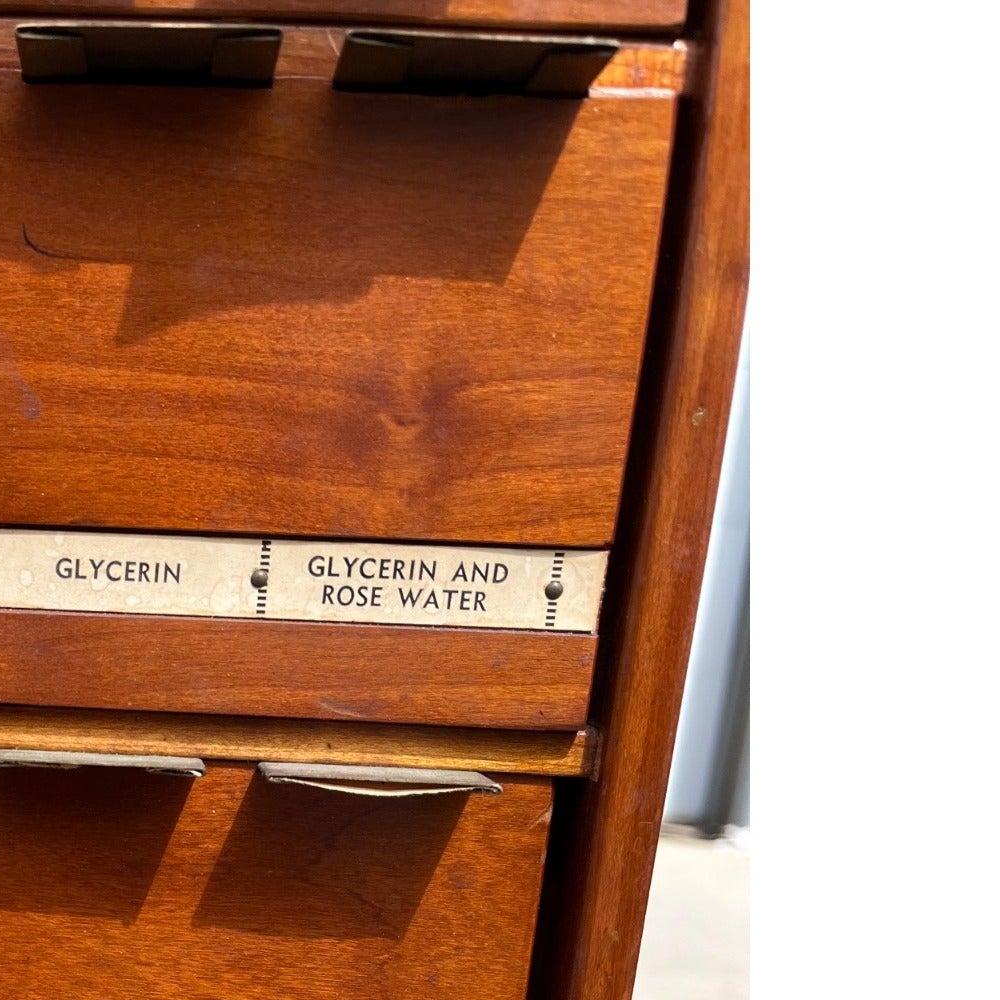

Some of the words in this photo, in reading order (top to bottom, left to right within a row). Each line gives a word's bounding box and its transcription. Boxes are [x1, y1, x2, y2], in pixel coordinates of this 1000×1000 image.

[54, 556, 183, 586] GLYCERIN
[307, 554, 438, 583] GLYCERIN
[450, 560, 510, 585] AND
[320, 583, 384, 609] ROSE
[397, 586, 488, 613] WATER
